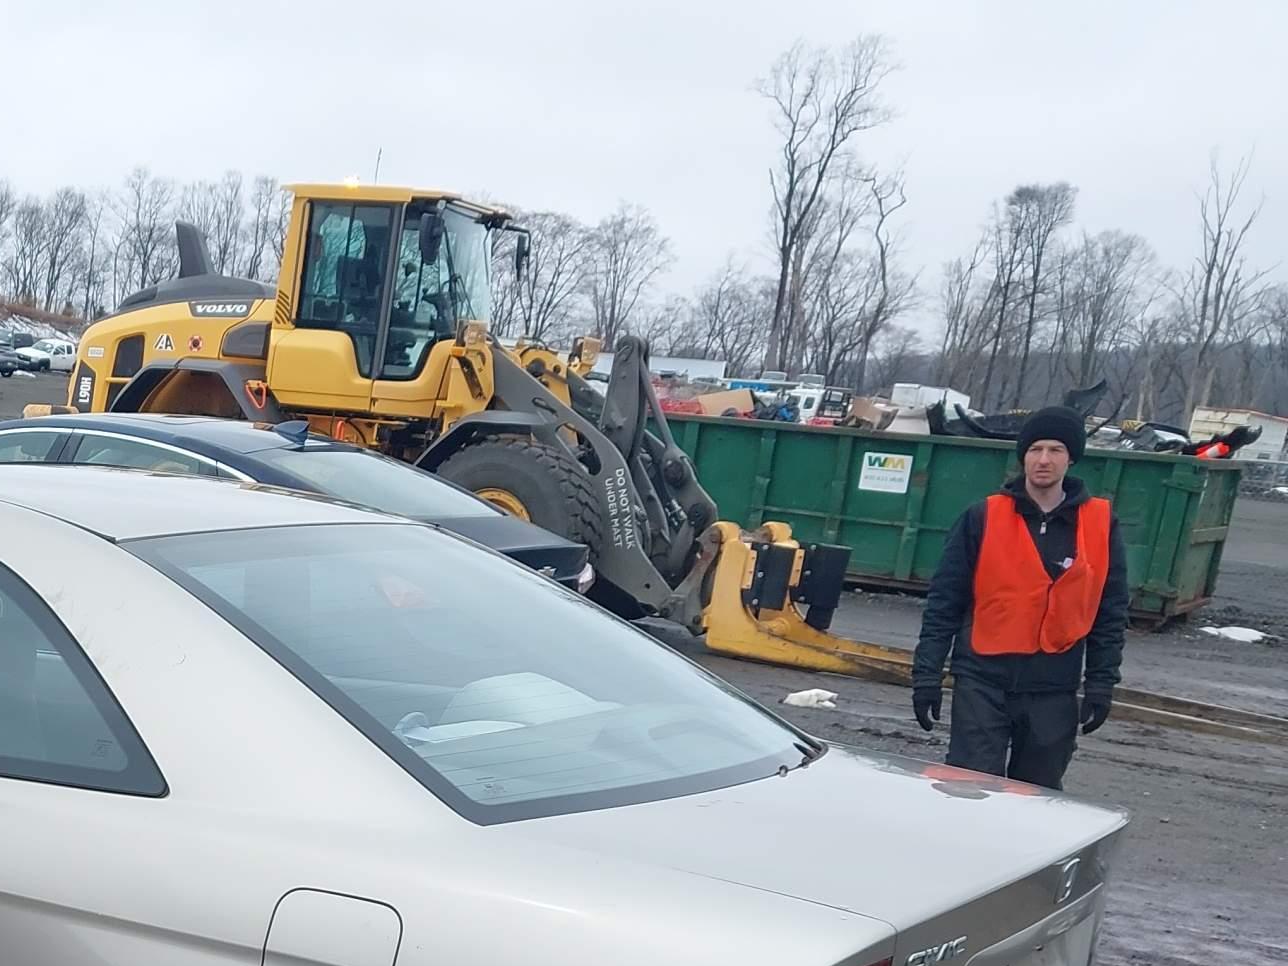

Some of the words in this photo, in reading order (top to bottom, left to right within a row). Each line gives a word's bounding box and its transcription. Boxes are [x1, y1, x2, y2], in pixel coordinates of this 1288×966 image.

[195, 304, 248, 313] VOLVO
[78, 376, 92, 403] L90H
[868, 455, 905, 470] WM
[615, 467, 626, 486] DO
[605, 478, 618, 516] UNDER
[618, 488, 630, 513] NOT
[611, 518, 623, 547] MAST
[623, 514, 635, 549] WALK
